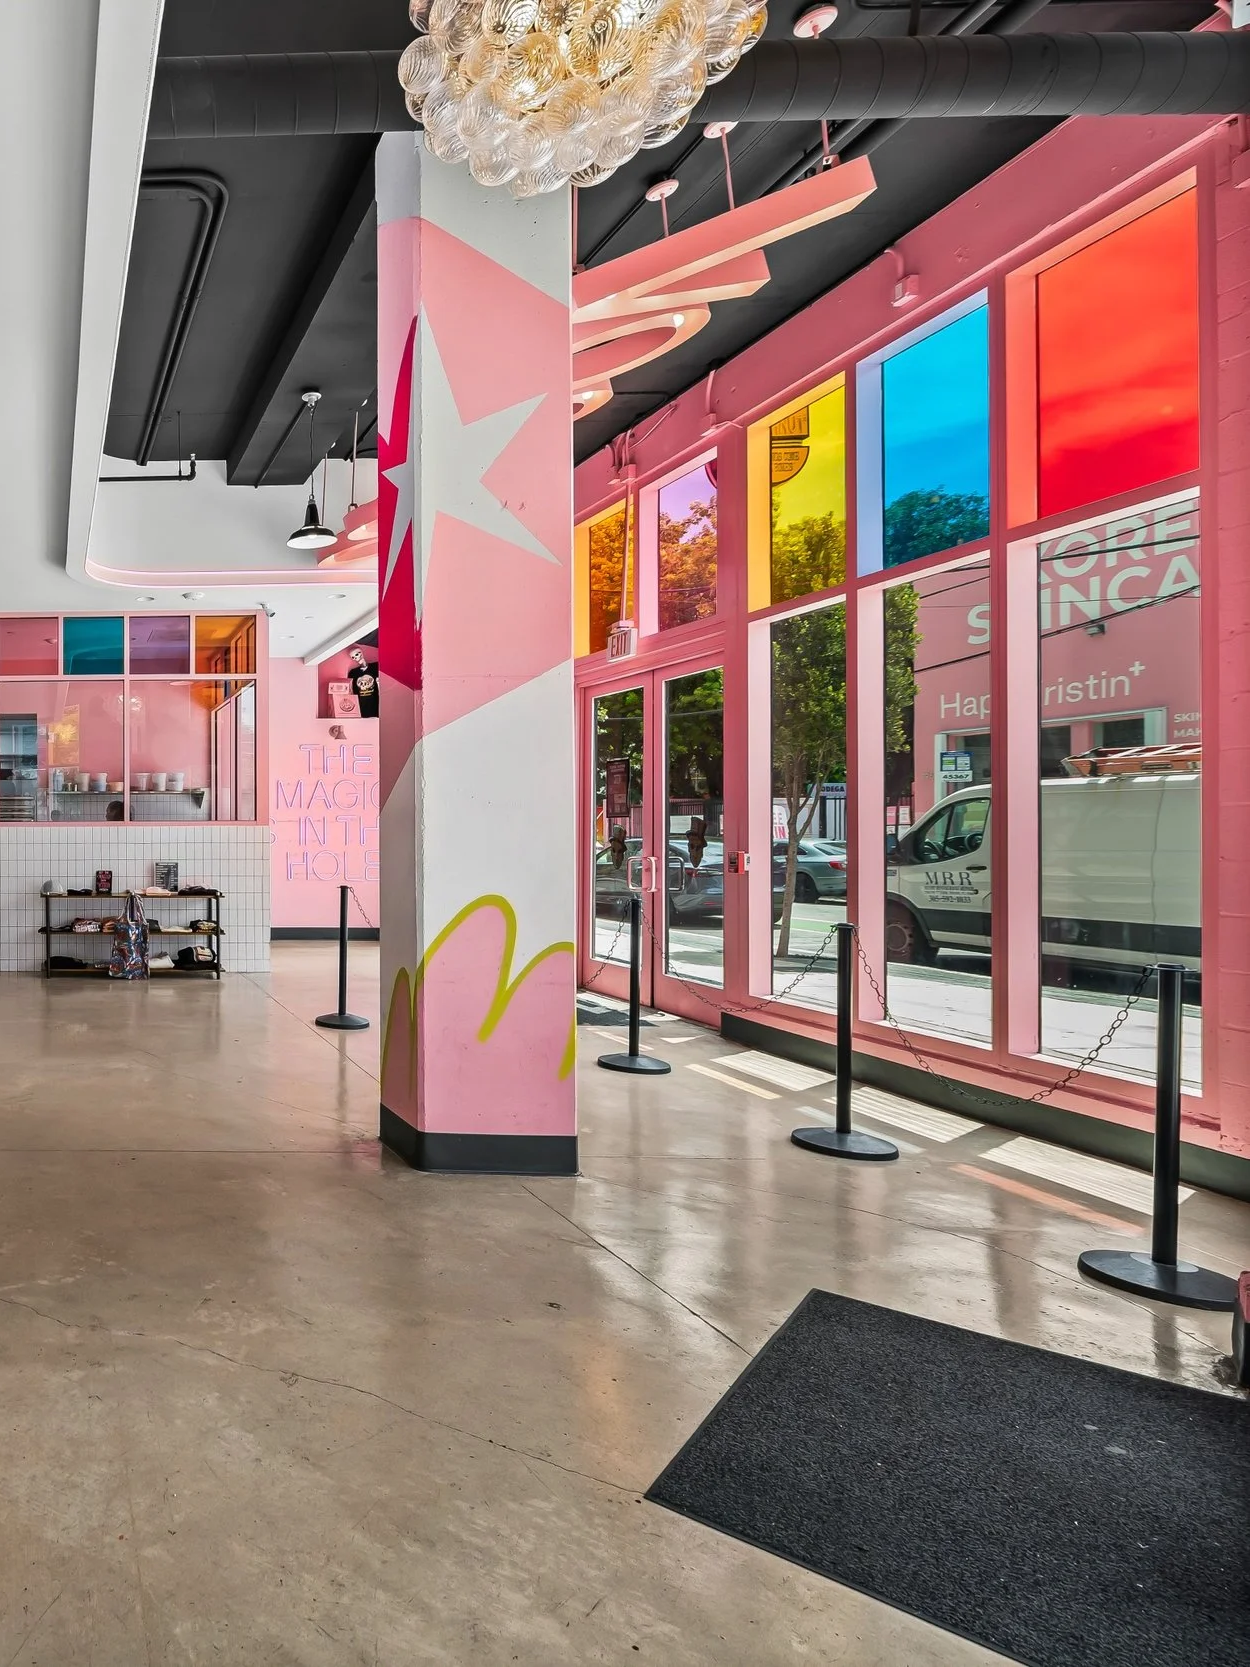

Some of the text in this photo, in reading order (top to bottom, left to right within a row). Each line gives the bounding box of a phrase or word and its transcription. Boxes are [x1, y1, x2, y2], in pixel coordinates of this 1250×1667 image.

[611, 632, 627, 657] EXIT
[299, 744, 374, 776] THE
[299, 815, 327, 846] IN
[336, 814, 380, 846] TH
[286, 850, 380, 881] HOLE
